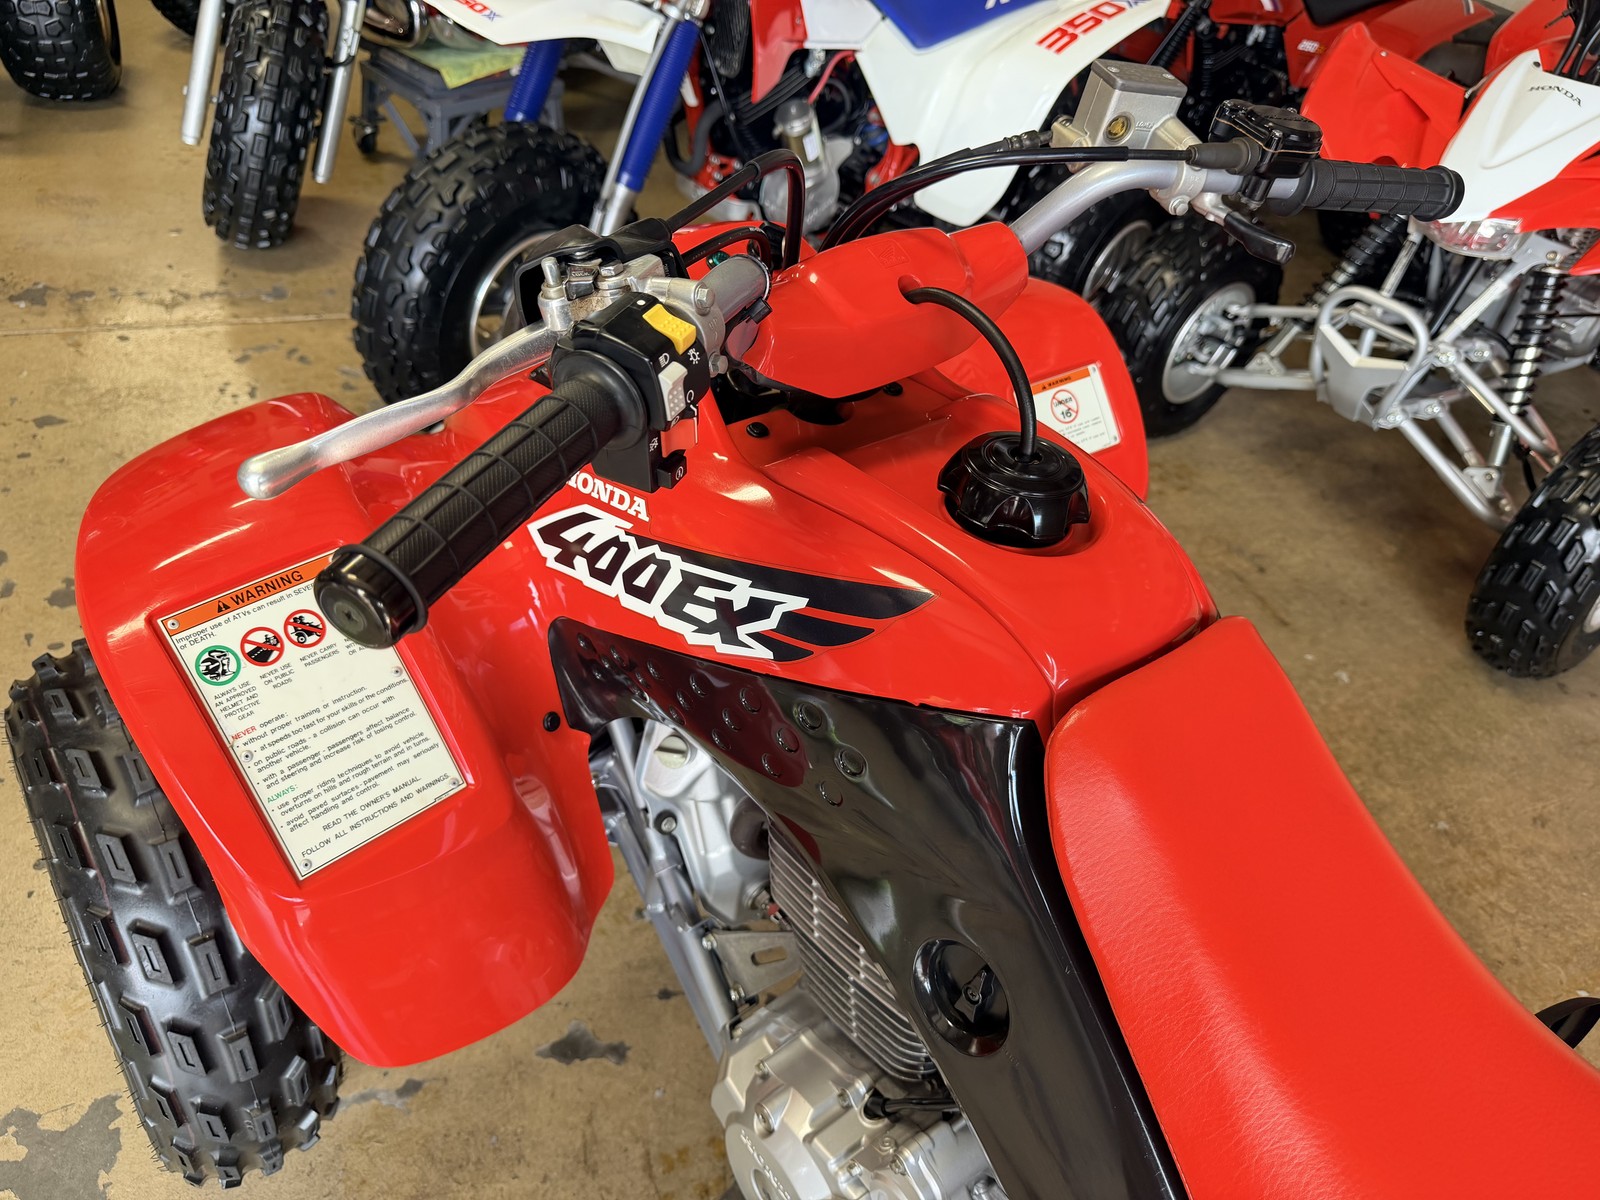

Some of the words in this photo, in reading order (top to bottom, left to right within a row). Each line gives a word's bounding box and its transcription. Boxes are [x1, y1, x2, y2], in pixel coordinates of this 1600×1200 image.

[1528, 85, 1582, 107] HONDA
[1061, 407, 1073, 419] 16
[229, 570, 304, 606] WARNING
[528, 505, 808, 659] 400EX
[174, 627, 208, 645] Improper
[209, 621, 223, 631] use
[252, 604, 266, 613] can
[265, 595, 286, 607] result
[299, 650, 319, 663] NEVER
[319, 642, 337, 654] CARRY
[303, 648, 340, 668] PASSENGERS
[259, 668, 280, 680] NEVER
[279, 662, 292, 671] USE
[273, 668, 295, 681] PUBLIC
[213, 686, 238, 701] ALWAYS
[237, 680, 251, 690] USE
[225, 685, 257, 703] APPROVED
[272, 677, 293, 690] ROADS
[219, 698, 244, 714] HELMET
[246, 692, 259, 702] AND
[223, 699, 261, 719] PROTECTIVE
[237, 710, 255, 721] GEAR
[259, 712, 289, 729] operate:
[267, 733, 292, 748] speeds
[291, 727, 304, 736] too
[302, 720, 317, 731] fast
[315, 716, 326, 724] for
[325, 708, 341, 721] your
[340, 701, 359, 713] skills
[364, 692, 376, 701] the
[230, 725, 257, 743] NEVER
[242, 731, 269, 747] without
[269, 720, 293, 735] proper
[294, 707, 321, 722] training
[253, 759, 264, 767] on
[264, 748, 286, 763] public
[287, 737, 307, 751] roads
[319, 719, 347, 735] collision
[347, 712, 361, 721] can
[361, 702, 380, 715] occur
[381, 695, 396, 705] with
[262, 772, 278, 783] with
[286, 750, 321, 772] passenger
[326, 730, 364, 752] passengers
[365, 719, 385, 732] affect
[384, 707, 410, 722] balance
[265, 778, 280, 790] and
[280, 765, 309, 782] steering
[309, 756, 323, 768] and
[322, 743, 352, 761] increase
[352, 736, 366, 746] risk
[373, 722, 394, 736] losing
[256, 757, 283, 774] another
[276, 800, 290, 811] use
[292, 787, 314, 804] proper
[316, 777, 337, 790] riding
[336, 758, 374, 779] techniques
[383, 742, 401, 756] avoid
[402, 731, 425, 745] vehicle
[280, 797, 313, 817] overturns
[313, 791, 323, 800] on
[322, 784, 338, 794] hills
[338, 775, 352, 787] and
[351, 766, 371, 780] rough
[370, 755, 393, 769] terrain
[393, 747, 406, 758] and
[285, 812, 305, 827] avoid
[307, 799, 329, 817] paved
[396, 757, 410, 768] may
[412, 742, 440, 760] seriously
[267, 784, 299, 804] ALWAYS:
[289, 818, 310, 833] affect
[310, 803, 340, 821] handling
[341, 794, 354, 805] and
[322, 817, 343, 832] READ
[342, 808, 359, 820] THE
[359, 790, 391, 812] OWNER'S
[301, 837, 332, 858] FOLLOW
[334, 829, 349, 840] ALL
[349, 800, 399, 832] INSTRUCTIONS
[400, 792, 414, 804] AND
